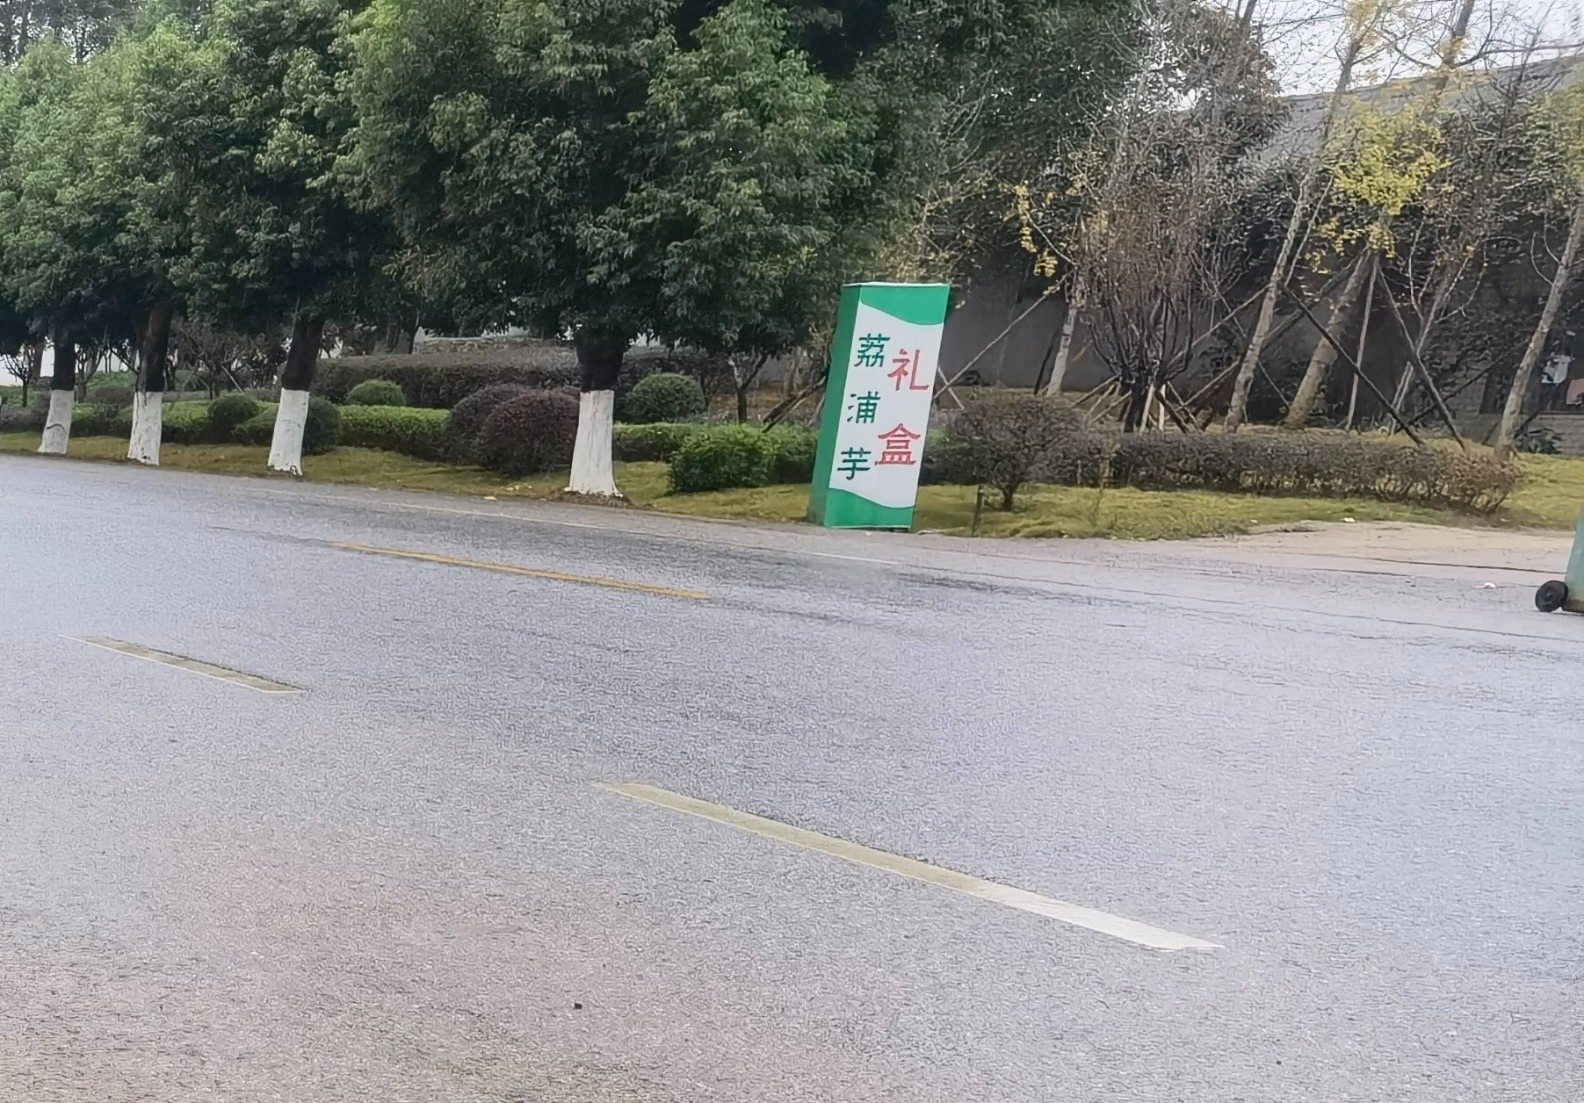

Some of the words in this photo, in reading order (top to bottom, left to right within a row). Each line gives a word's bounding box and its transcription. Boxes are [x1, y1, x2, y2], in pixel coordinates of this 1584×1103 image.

[836, 333, 890, 481] 荔浦芋
[874, 348, 930, 466] 礼盒
